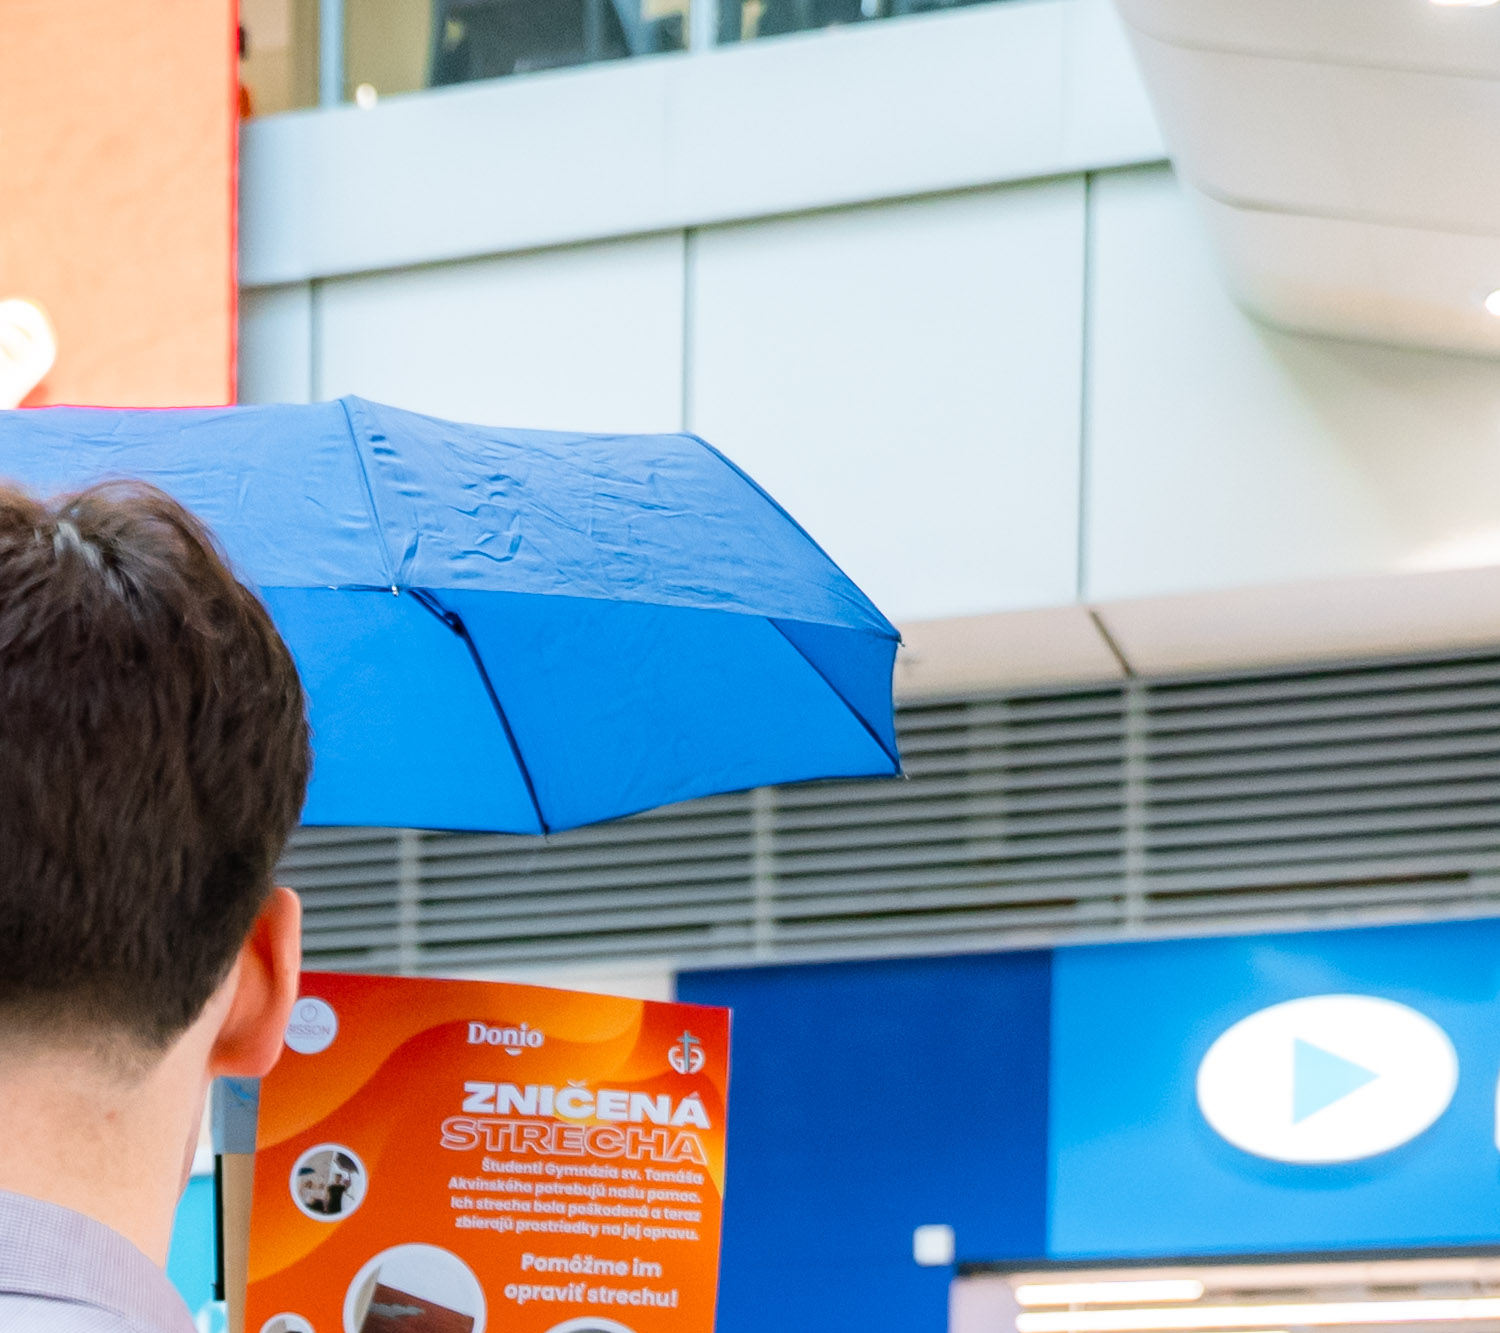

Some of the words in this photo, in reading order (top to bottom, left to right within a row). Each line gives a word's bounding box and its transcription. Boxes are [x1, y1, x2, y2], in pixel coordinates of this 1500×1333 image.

[467, 1021, 544, 1049] Donio
[462, 1078, 711, 1129] ZNIČENÁ
[440, 1115, 709, 1165] STRECHA
[481, 1157, 543, 1174] Študenti
[545, 1161, 619, 1179] Gymnázia
[644, 1168, 704, 1185] Tomáša
[535, 1181, 606, 1198] potrebujú
[608, 1185, 645, 1199] našu
[451, 1196, 473, 1209] Ich
[476, 1198, 531, 1212] strecha
[533, 1201, 566, 1214] bola
[568, 1202, 648, 1218] poškodená
[650, 1208, 661, 1218] a
[664, 1207, 701, 1222] teraz
[455, 1215, 513, 1232] zbierajú
[516, 1220, 600, 1237] prostriedky
[601, 1224, 621, 1236] na
[521, 1252, 629, 1275] Pomôžme
[632, 1258, 662, 1277] im
[504, 1282, 586, 1304] opraviť
[587, 1287, 679, 1308] strechu!
